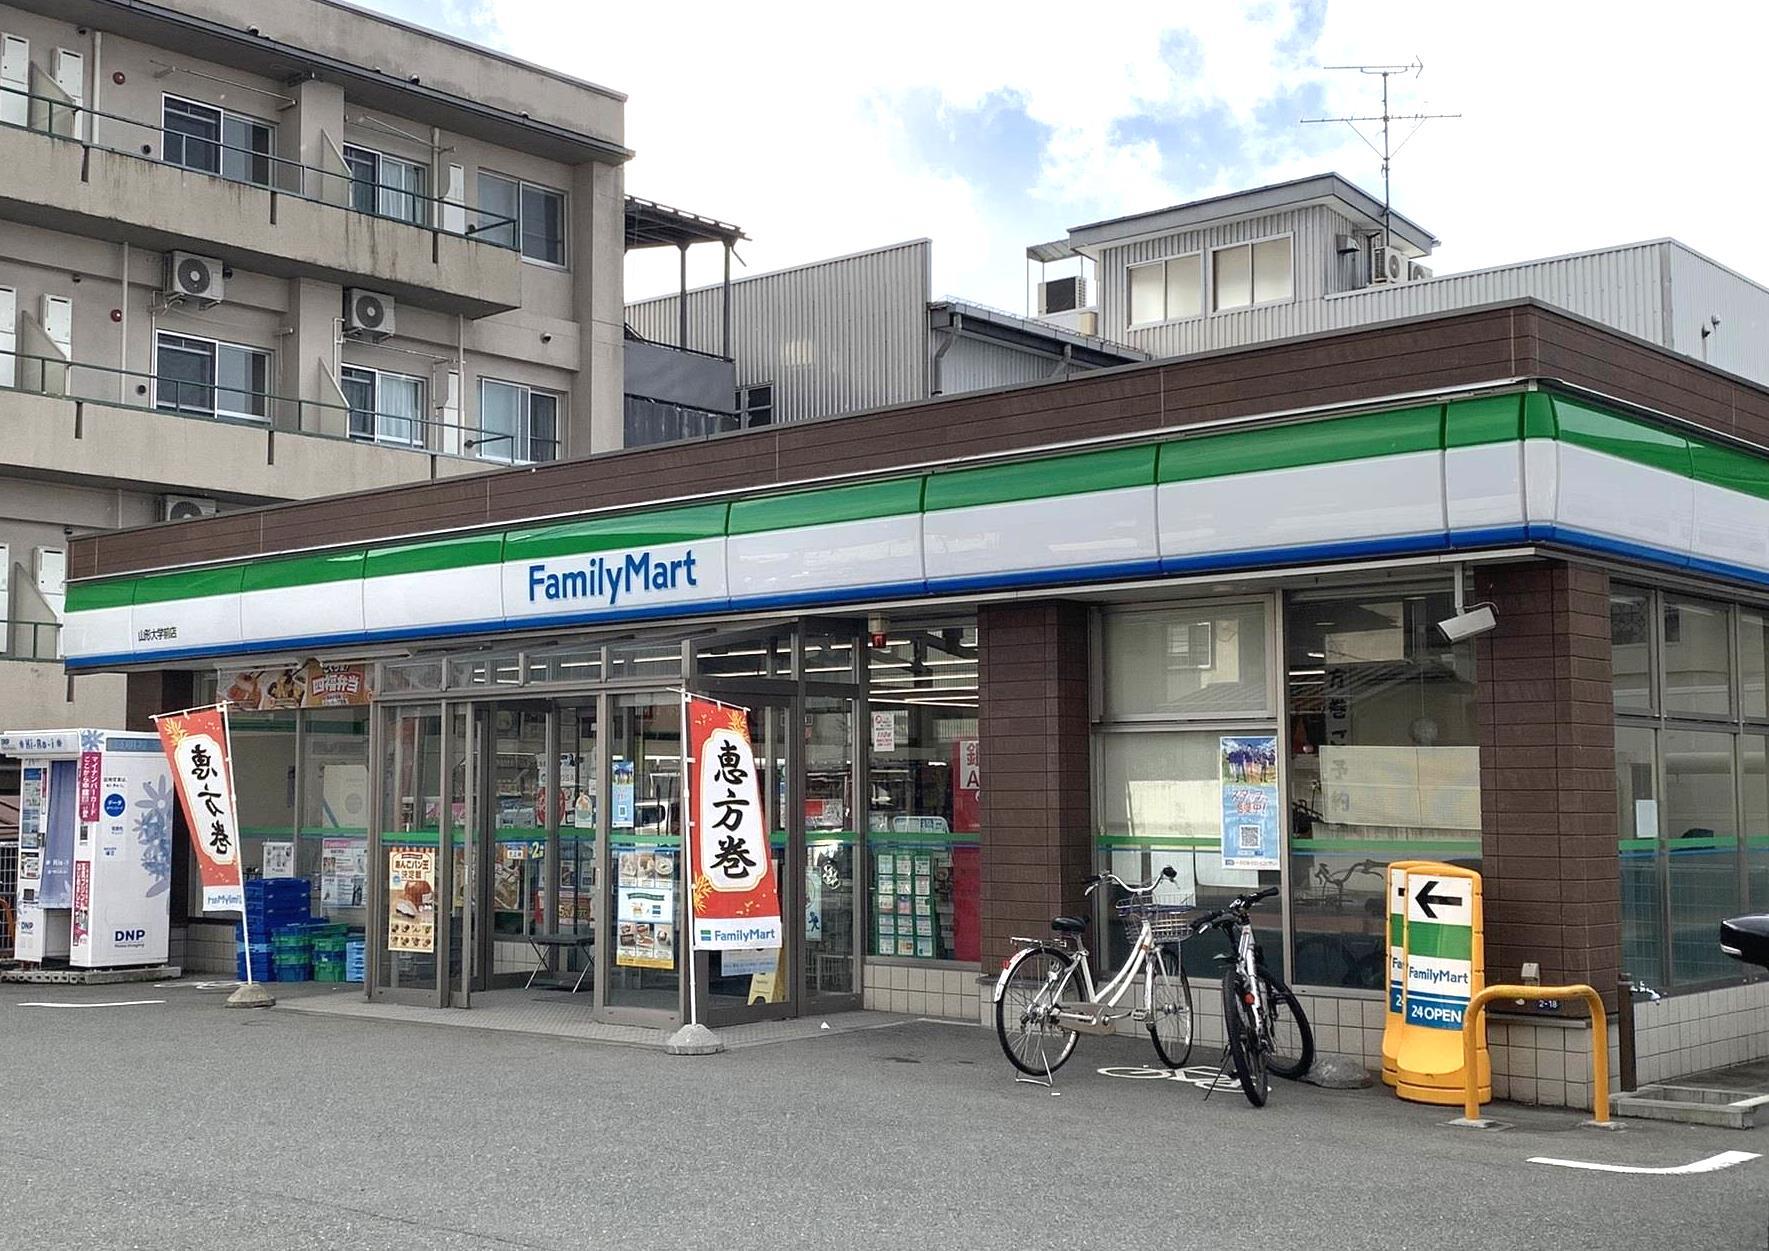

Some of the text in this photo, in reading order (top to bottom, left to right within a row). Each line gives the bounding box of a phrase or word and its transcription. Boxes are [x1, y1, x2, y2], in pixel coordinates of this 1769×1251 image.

[529, 550, 697, 605] FamilyMart
[138, 626, 177, 641] 山形大学前店
[710, 739, 757, 879] 恵方巻
[115, 929, 146, 942] DNP
[714, 929, 775, 942] FamilyMart
[1408, 966, 1469, 985] FamilyMart
